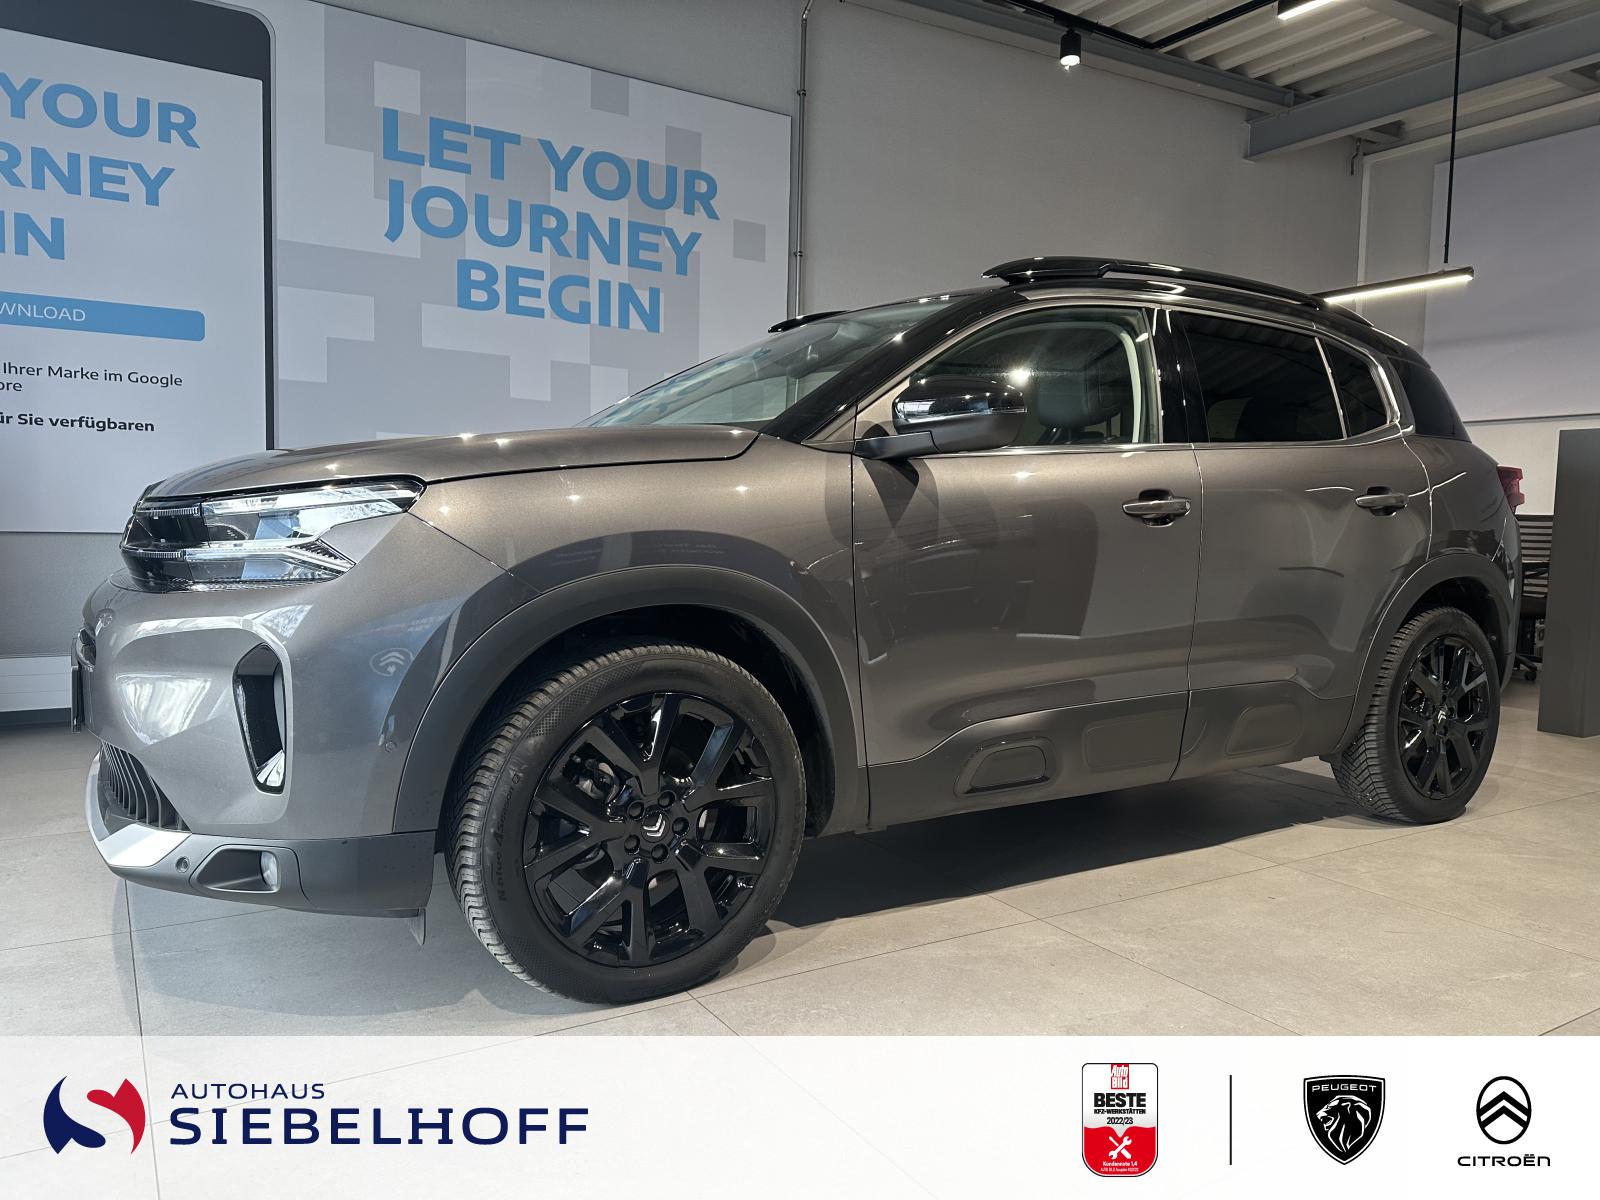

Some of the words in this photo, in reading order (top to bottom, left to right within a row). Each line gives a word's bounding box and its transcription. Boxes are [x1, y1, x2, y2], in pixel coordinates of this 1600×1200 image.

[0, 72, 200, 148] YOUR
[382, 107, 521, 181] LET
[537, 138, 720, 220] YOUR
[383, 178, 702, 276] JOURNEY
[456, 258, 661, 333] BEGIN
[3, 362, 43, 377] Ihrer
[48, 365, 99, 380] Marke
[104, 369, 123, 382] im
[127, 371, 183, 388] Google
[17, 413, 44, 426] Sie
[48, 416, 155, 432] verfügbaren
